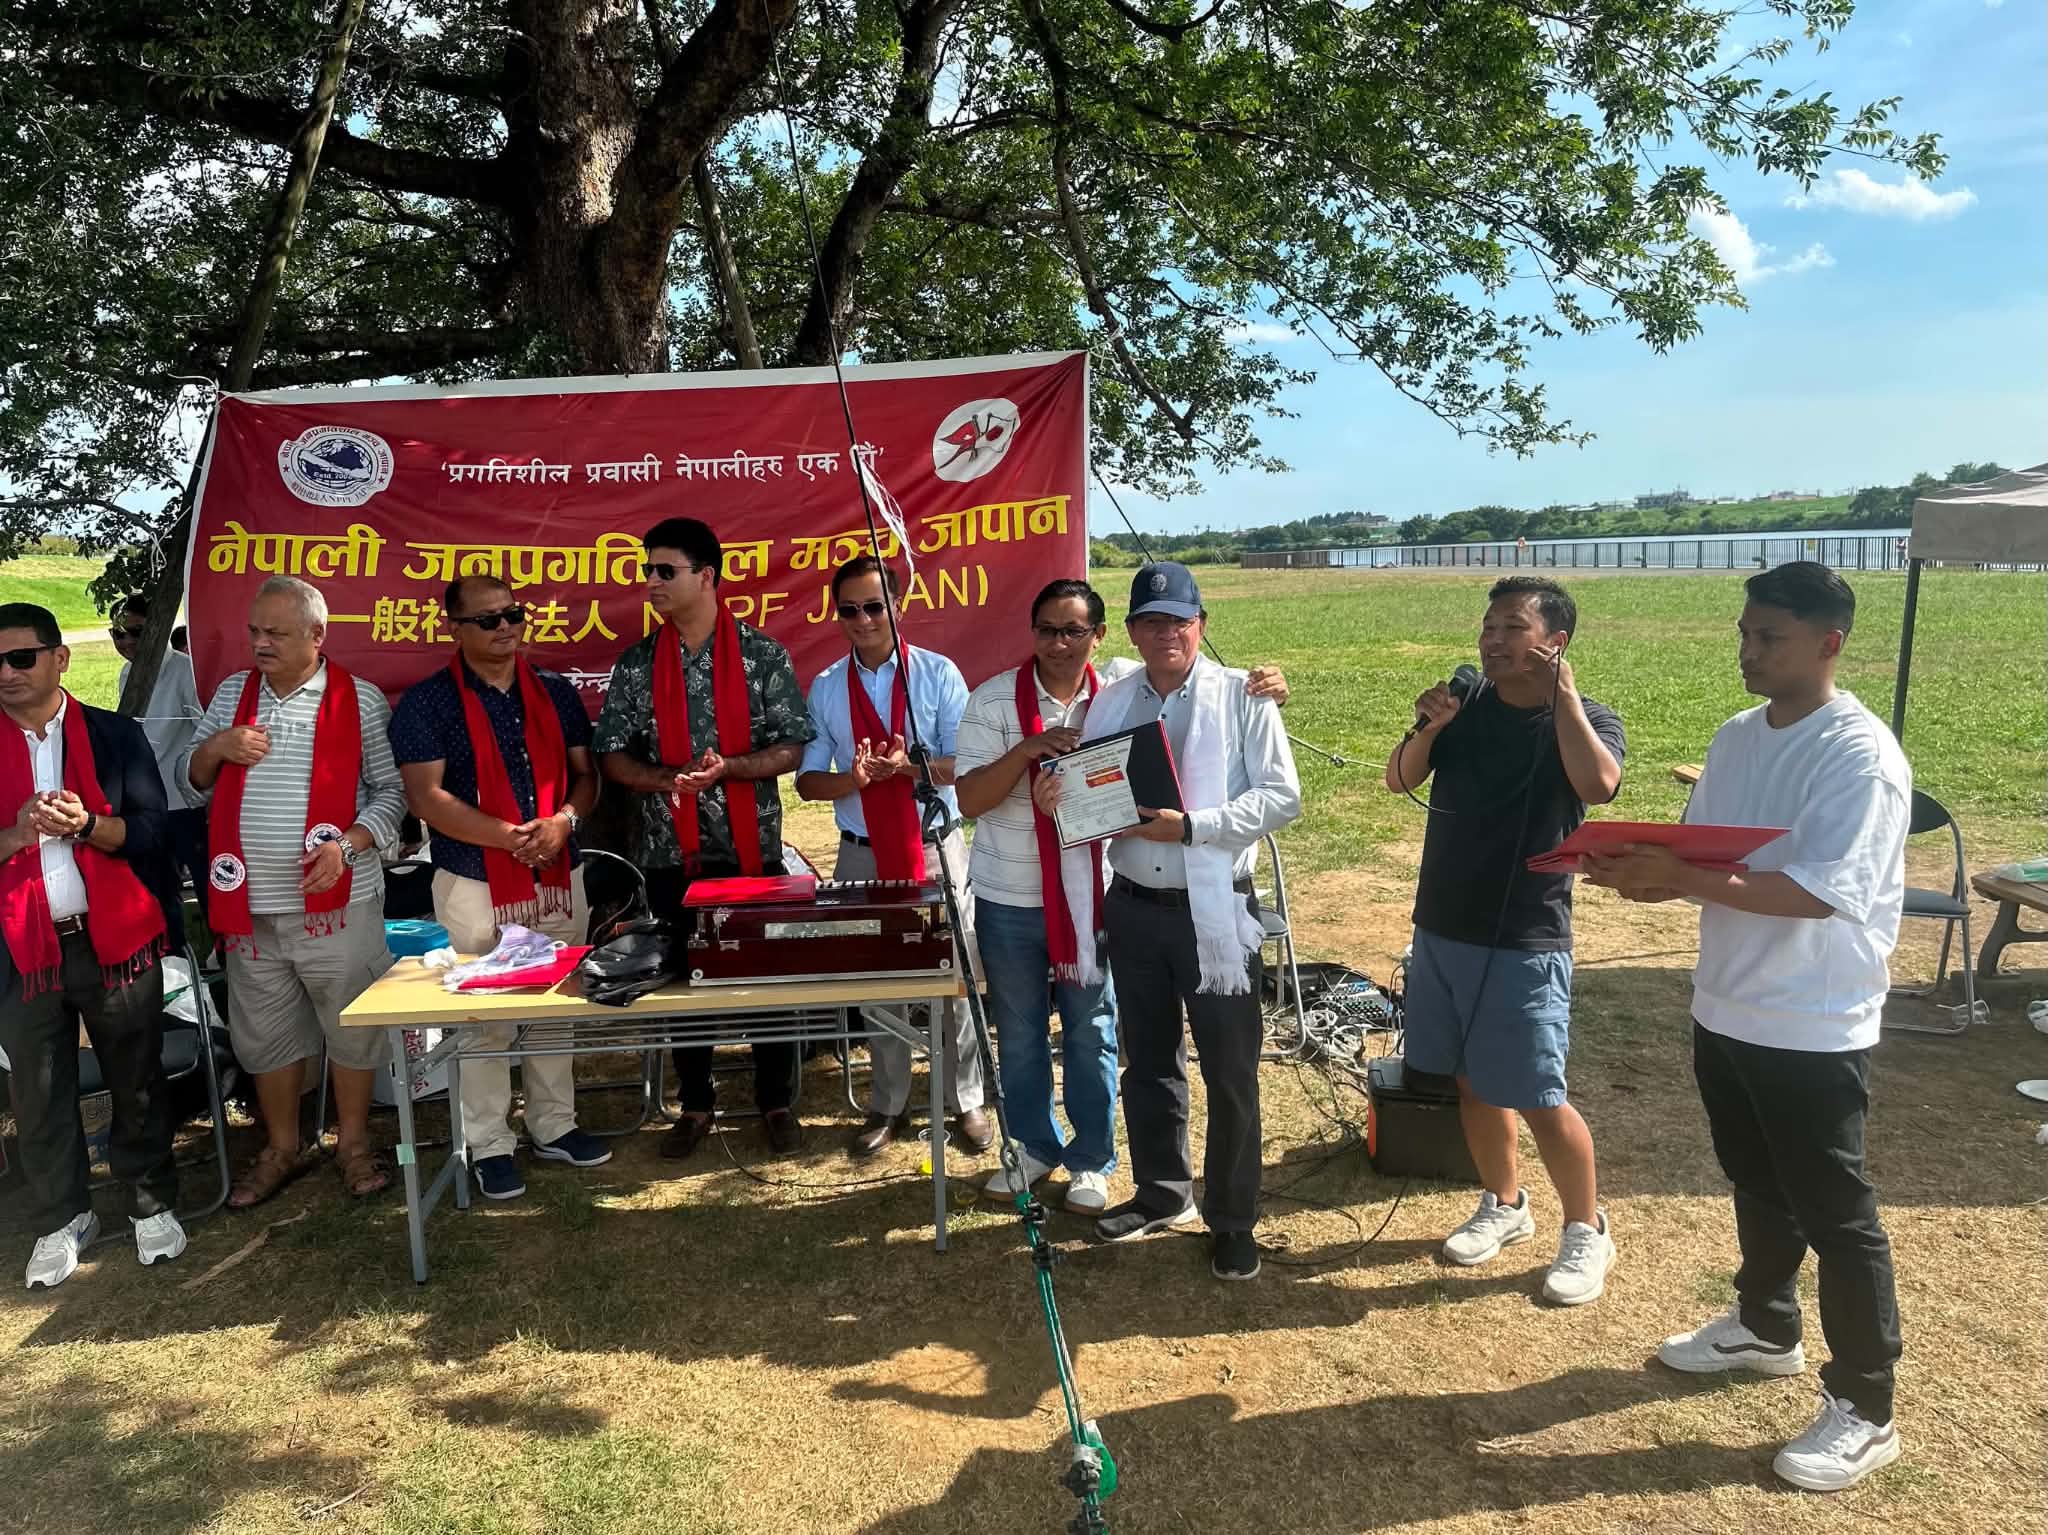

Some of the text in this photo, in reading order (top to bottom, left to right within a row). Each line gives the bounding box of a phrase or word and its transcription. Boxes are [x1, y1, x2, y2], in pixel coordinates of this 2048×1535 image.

[586, 453, 663, 484] प्रवासी
[797, 452, 840, 481] एक
[208, 520, 387, 578] नेपाली
[402, 532, 774, 590] जनप्रगतिल
[918, 495, 1072, 553] जापान
[327, 596, 619, 643] 一般社法人
[806, 564, 989, 624] JAN)
